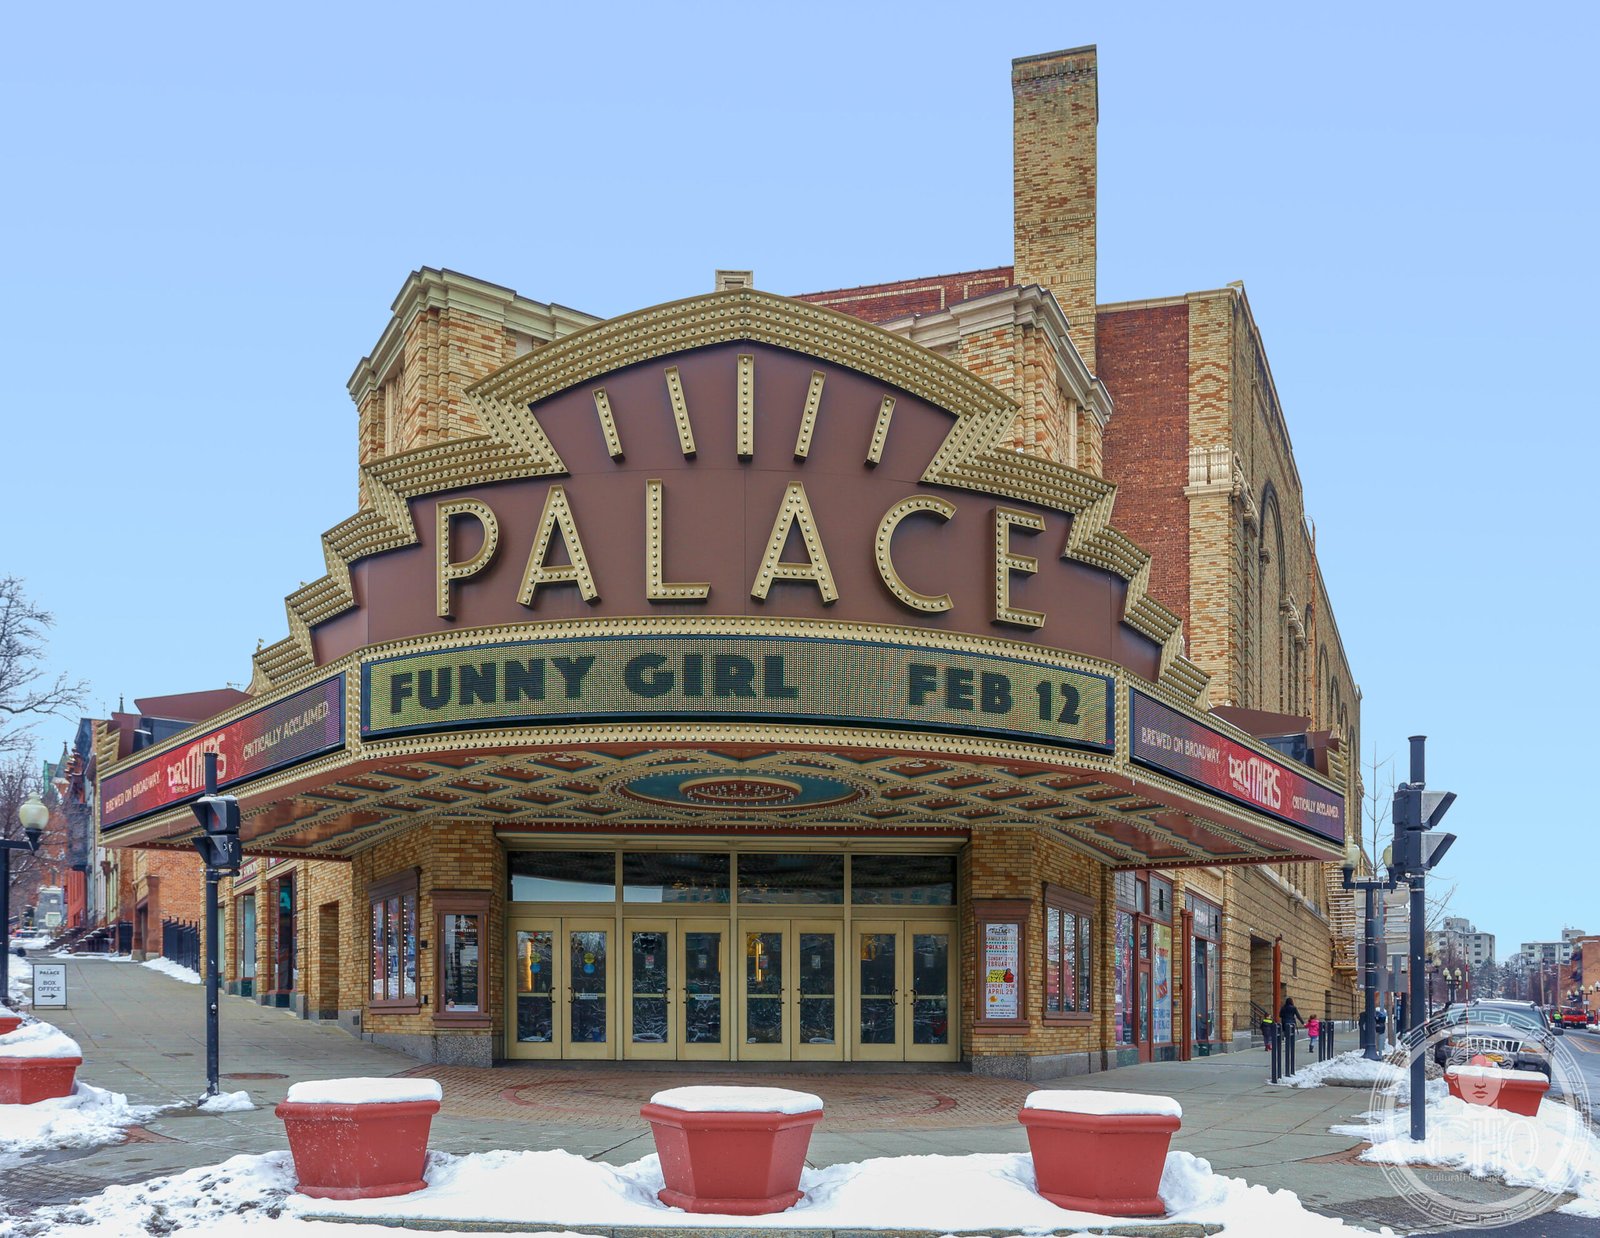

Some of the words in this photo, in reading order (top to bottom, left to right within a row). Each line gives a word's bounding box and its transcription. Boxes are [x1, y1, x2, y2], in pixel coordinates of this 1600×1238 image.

[435, 478, 1047, 629] PALACE
[390, 656, 598, 714] FUNNY
[624, 653, 799, 698] GIRL
[908, 663, 1013, 715] FEB
[1036, 678, 1082, 726] 12
[167, 733, 227, 789] DRUTHS
[243, 725, 283, 761] CRITICALLY
[1141, 726, 1173, 751] BREWED
[1228, 753, 1281, 810] DRUTHERS
